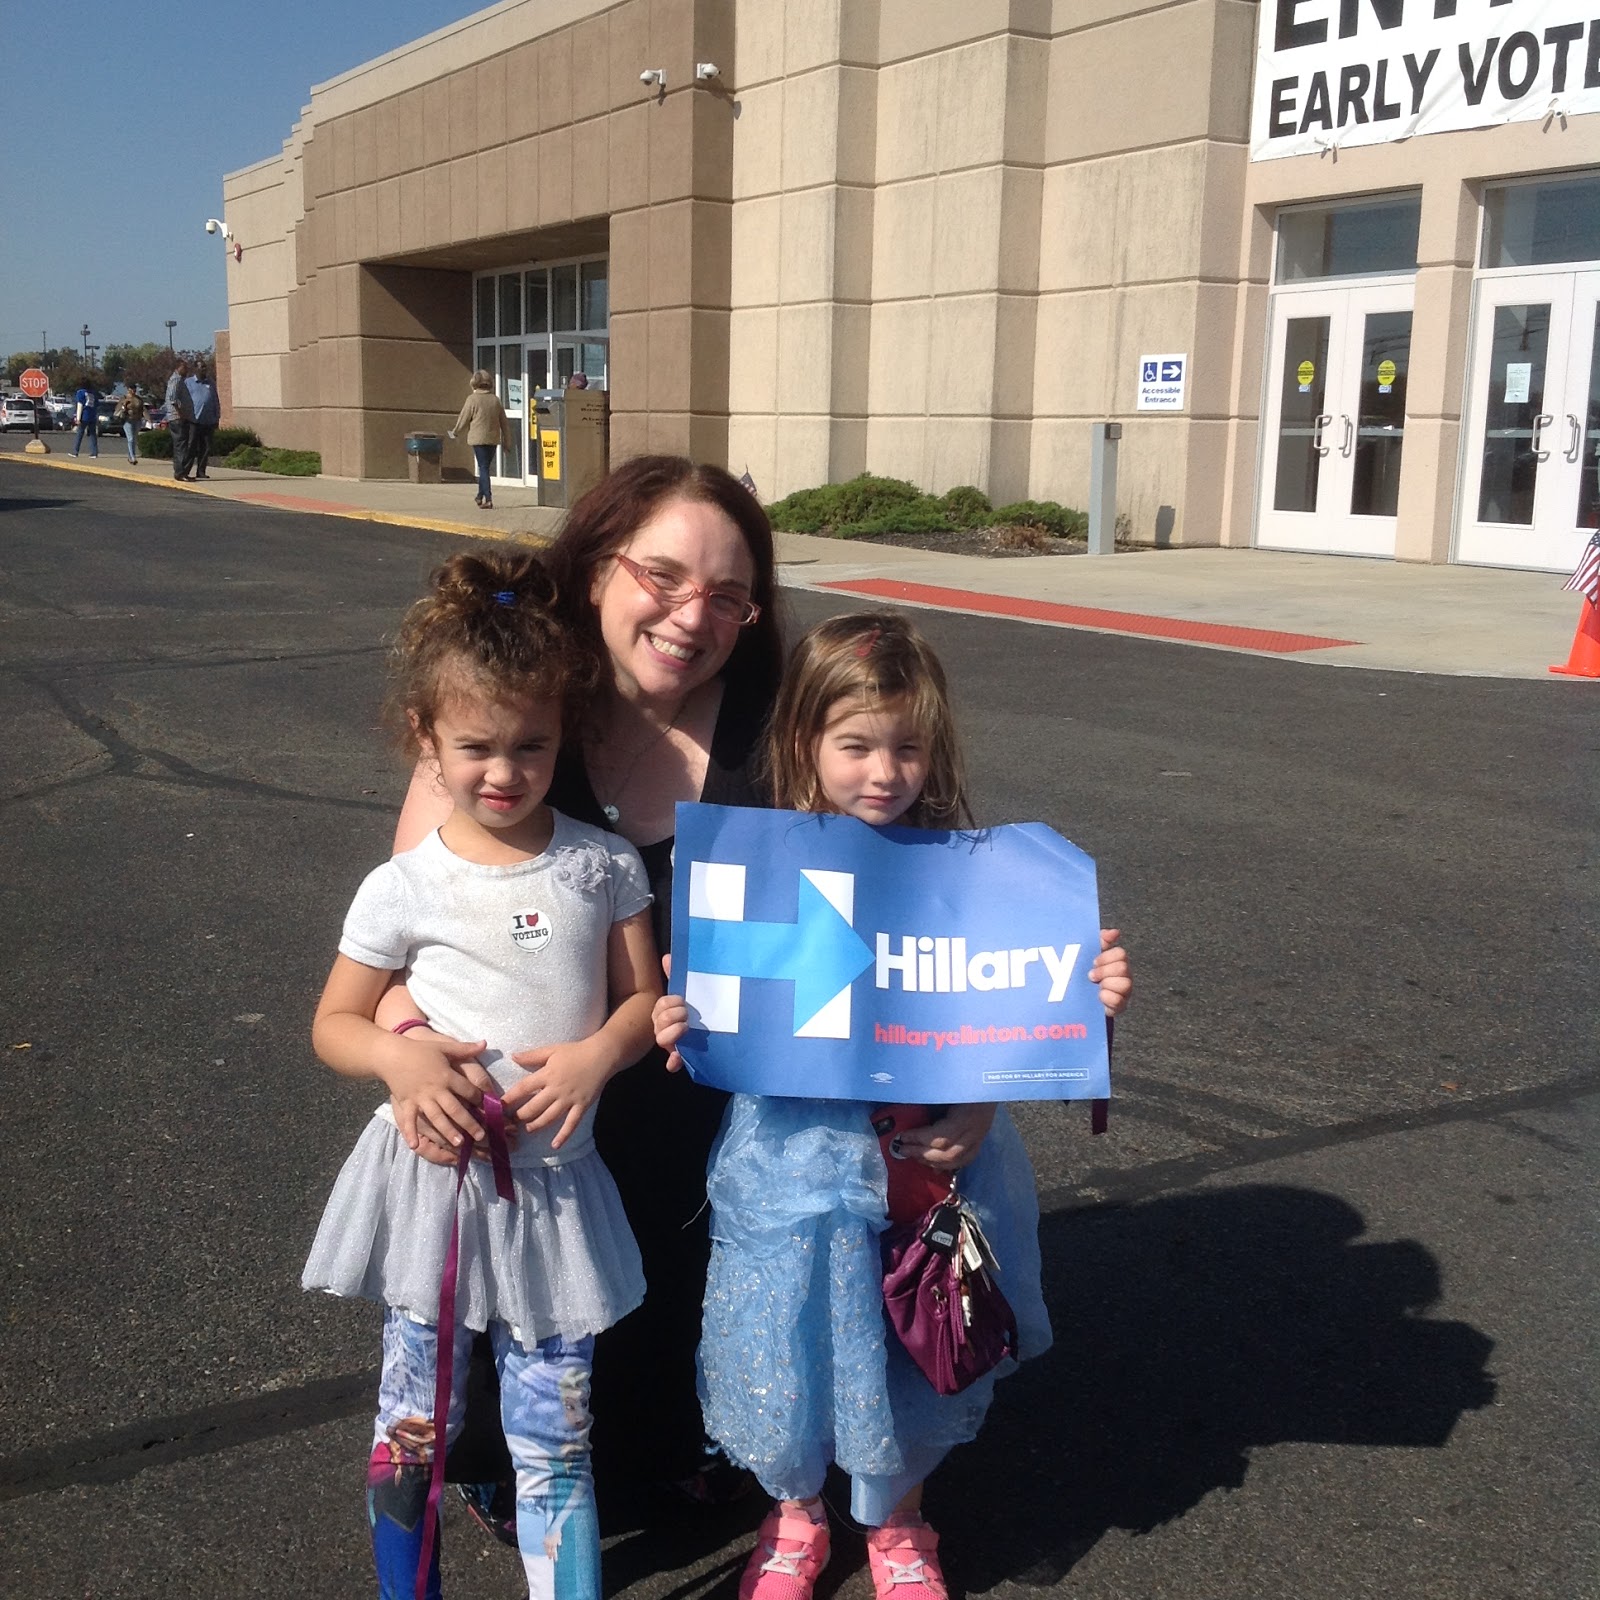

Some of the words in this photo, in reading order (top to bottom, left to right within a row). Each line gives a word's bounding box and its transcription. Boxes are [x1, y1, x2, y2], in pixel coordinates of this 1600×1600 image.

[1269, 48, 1442, 139] EARLY
[22, 377, 46, 388] STOP
[1142, 387, 1181, 395] Accessible
[512, 914, 525, 929] I
[511, 927, 549, 941] VOTING
[875, 932, 1081, 1003] Hillary
[874, 1021, 1088, 1051] hillaryclinton.com
